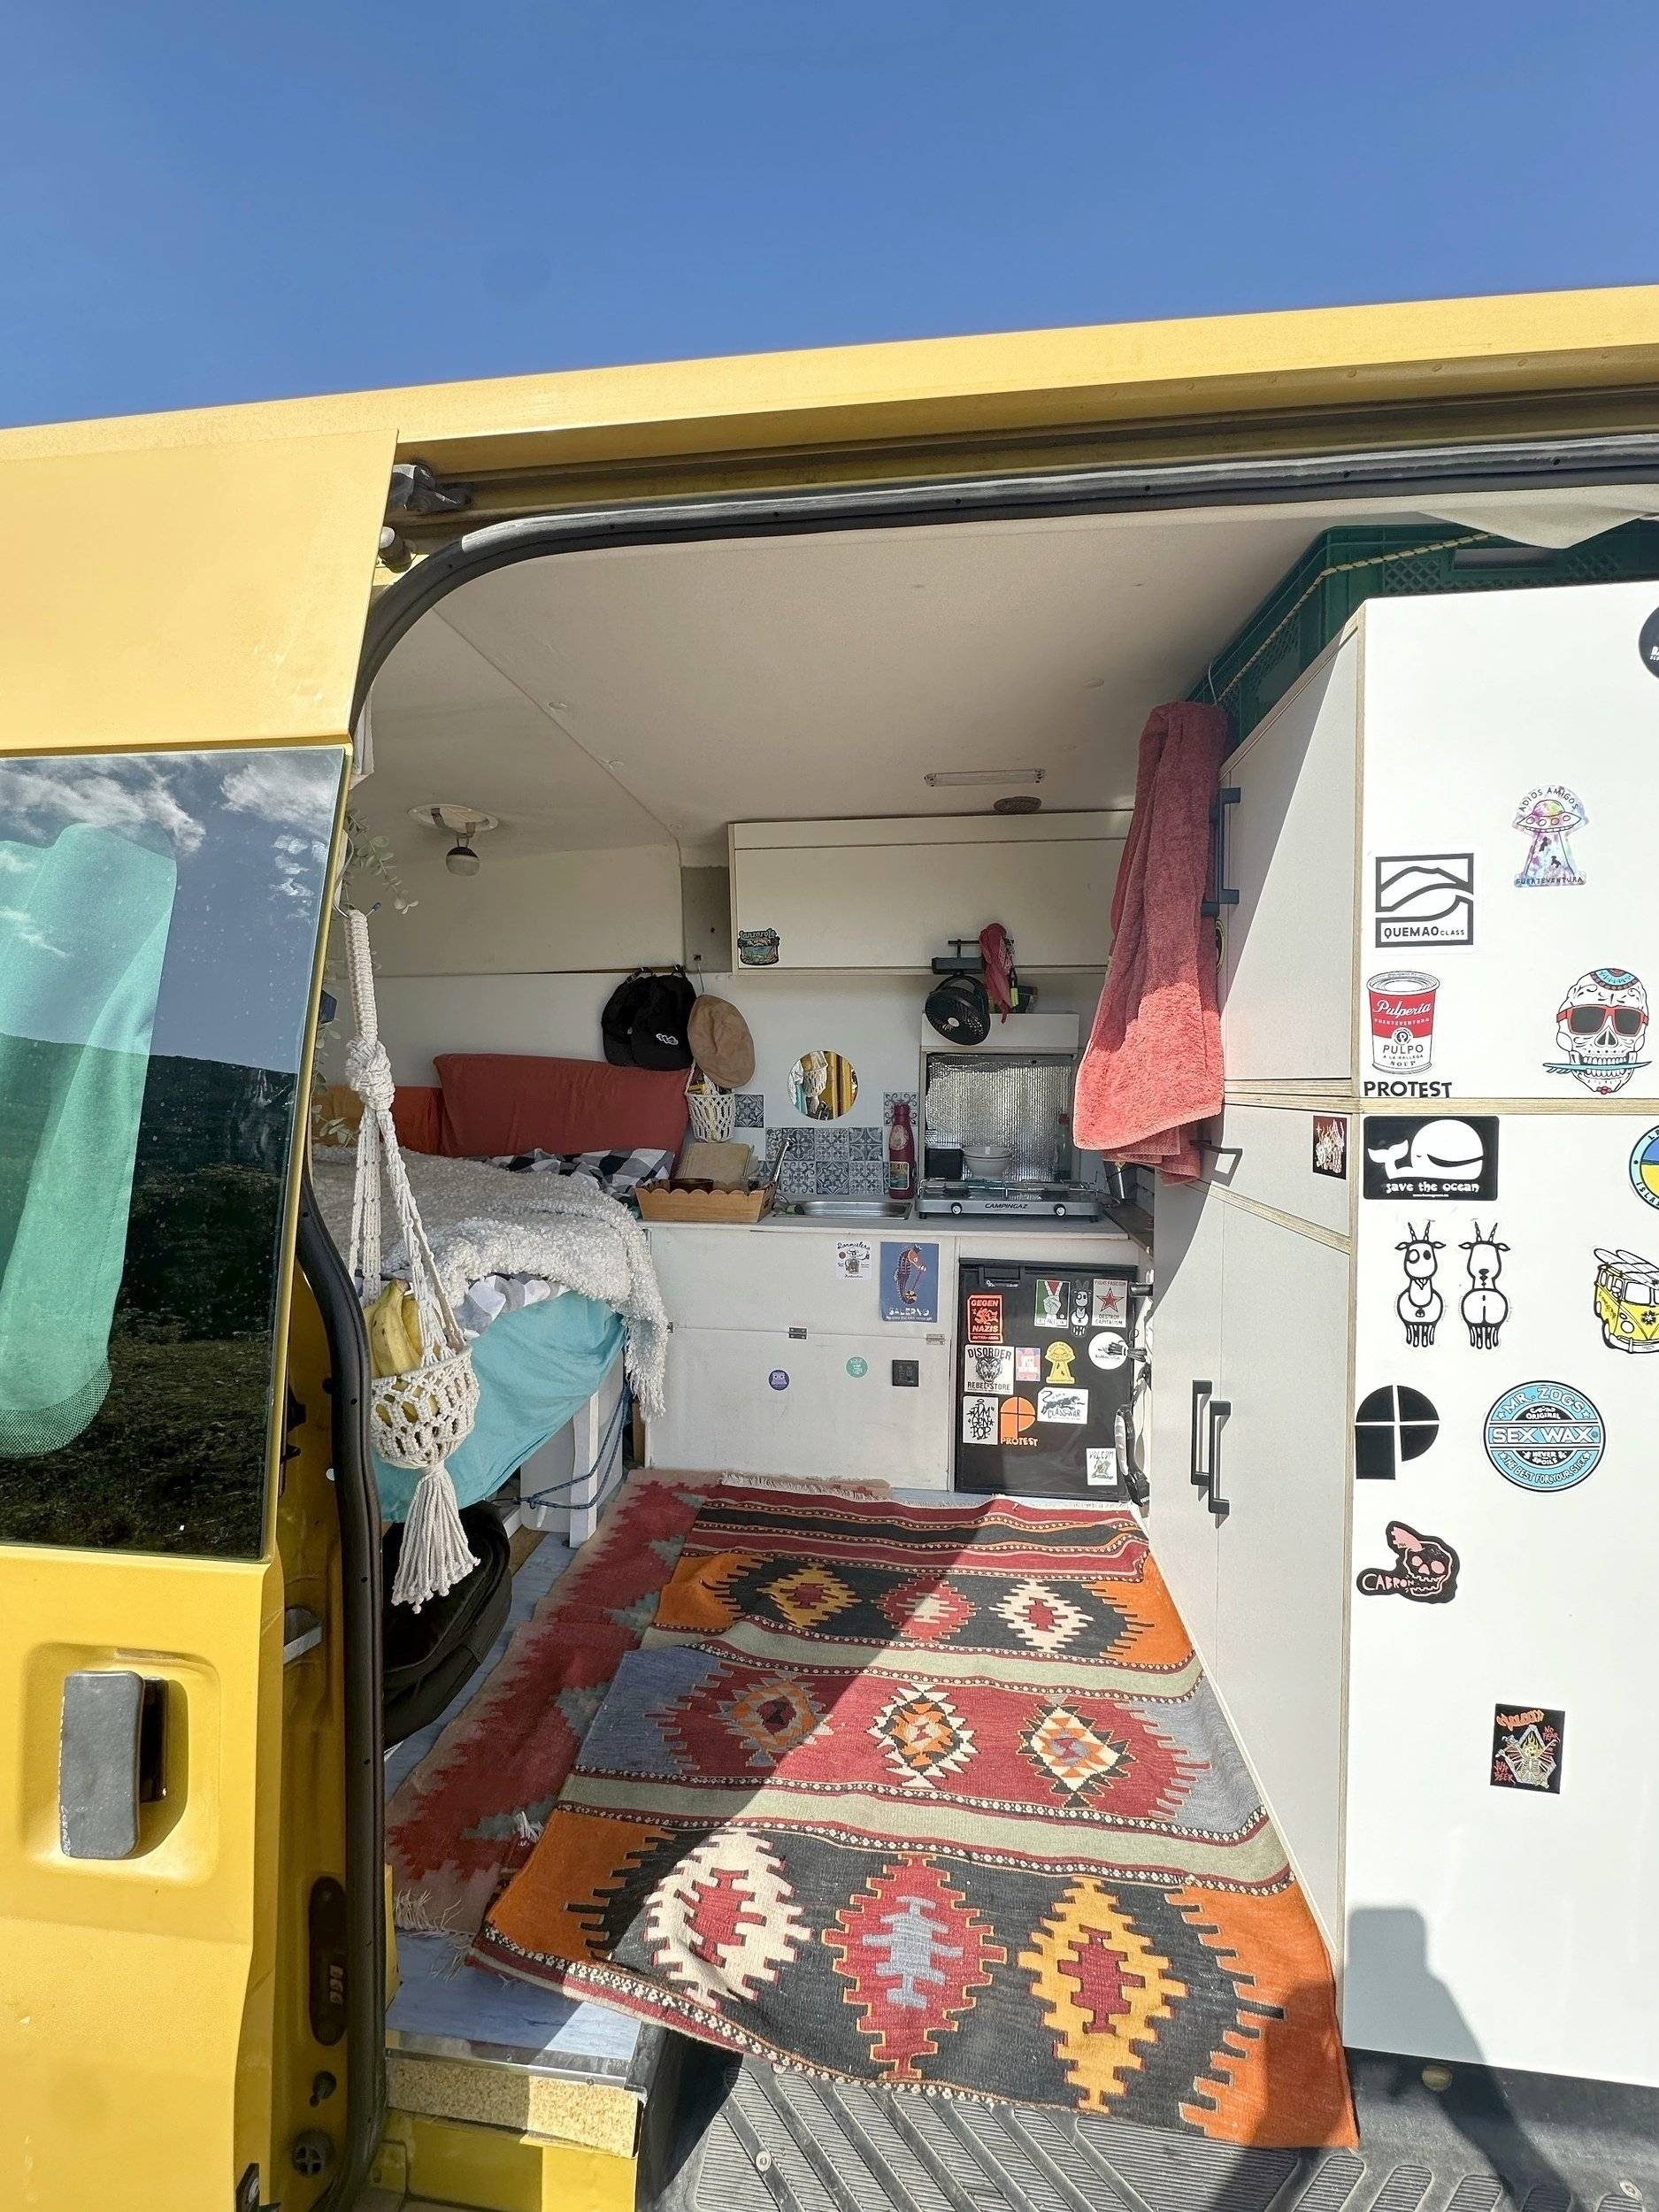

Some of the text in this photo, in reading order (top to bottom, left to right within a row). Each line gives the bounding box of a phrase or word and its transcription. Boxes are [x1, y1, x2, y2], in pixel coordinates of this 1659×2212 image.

[1518, 787, 1578, 812] ADIOS AMIGOS
[1516, 876, 1584, 885] FUERTEVENTURA
[1384, 926, 1439, 939] QUEMAO
[1383, 1044, 1424, 1054] PULPO
[1363, 1081, 1452, 1098] PROTEST
[1386, 1181, 1479, 1194] save the ocean
[888, 1307, 930, 1317] SALERNO
[968, 1348, 1011, 1361] DISORDER
[1537, 1387, 1585, 1412] ZOGS
[1493, 1426, 1594, 1443] SEX WAX
[1001, 1437, 1038, 1446] PROTEST
[1503, 1455, 1589, 1484] THE BEST FOR YOUR STICK
[1362, 1573, 1413, 1591] CABRON
